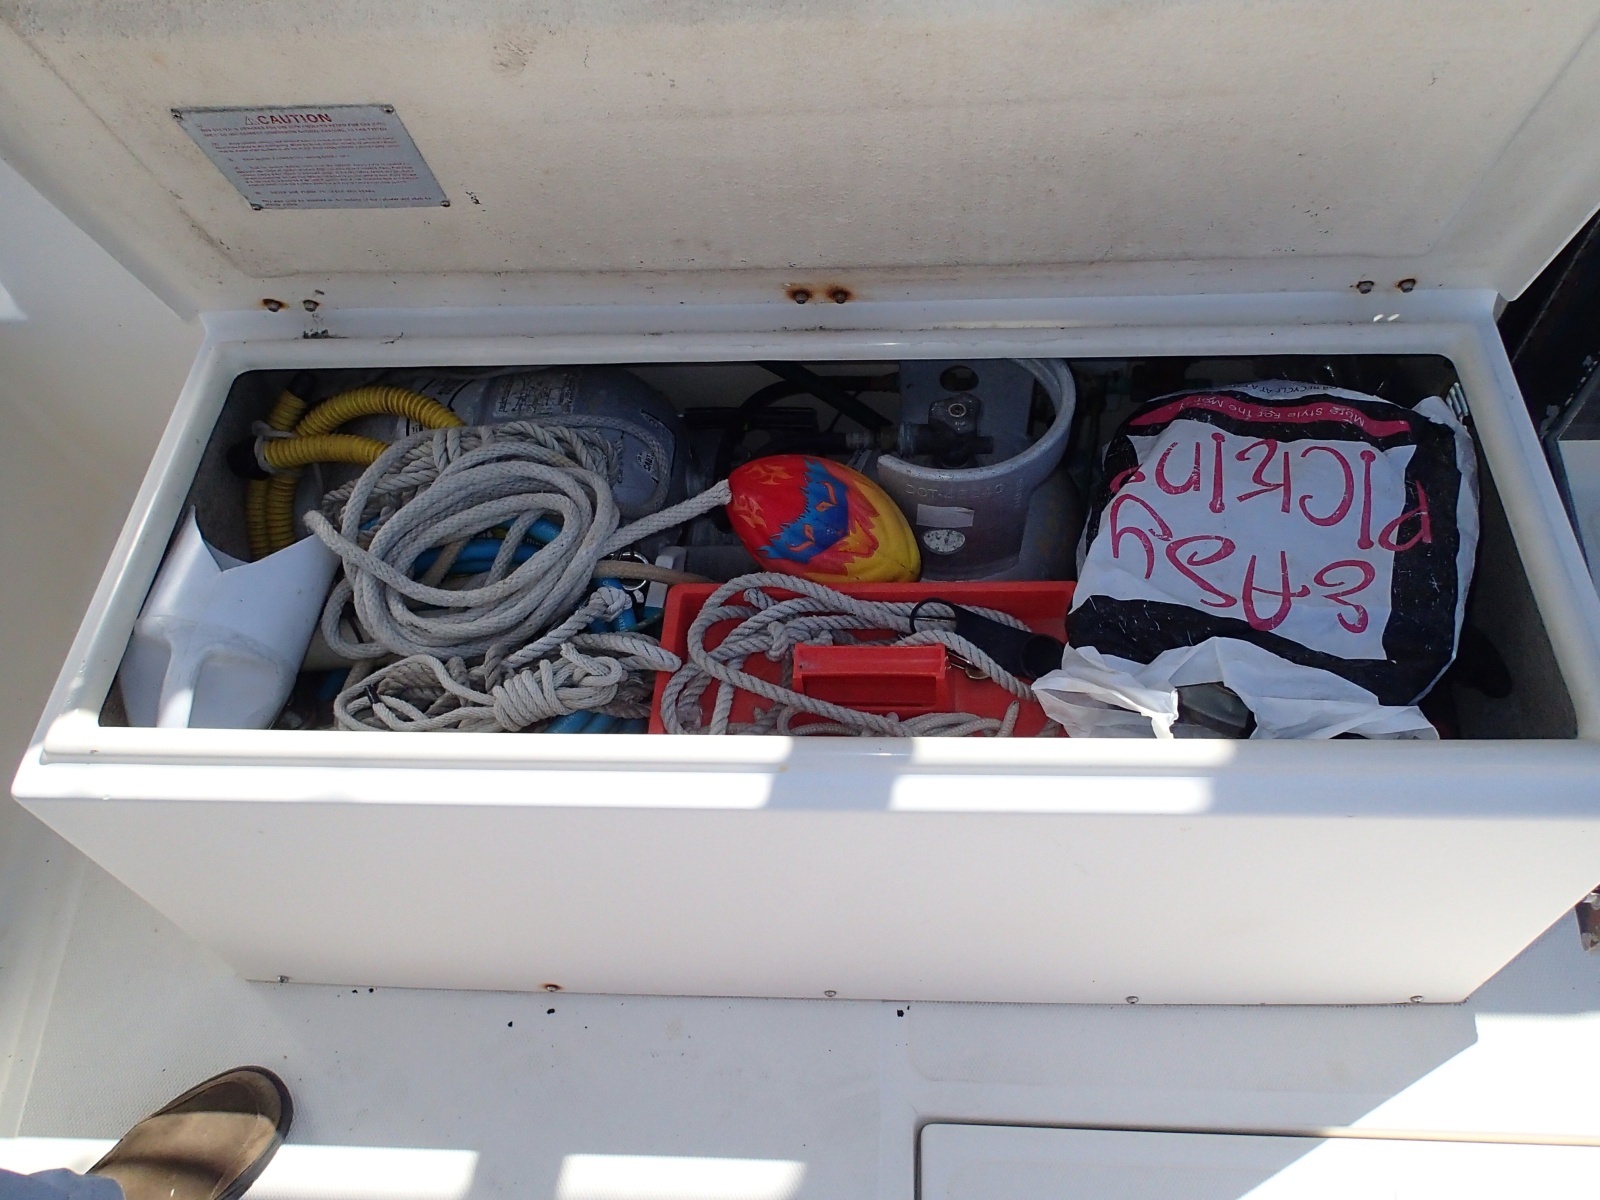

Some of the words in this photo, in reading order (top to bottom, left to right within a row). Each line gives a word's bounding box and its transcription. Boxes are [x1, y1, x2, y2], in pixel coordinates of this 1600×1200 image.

[257, 113, 332, 125] CAUTION
[1228, 404, 1253, 418] The
[1257, 410, 1281, 419] For
[1287, 407, 1323, 418] Style
[1329, 405, 1365, 427] More
[1109, 494, 1376, 634] EASY
